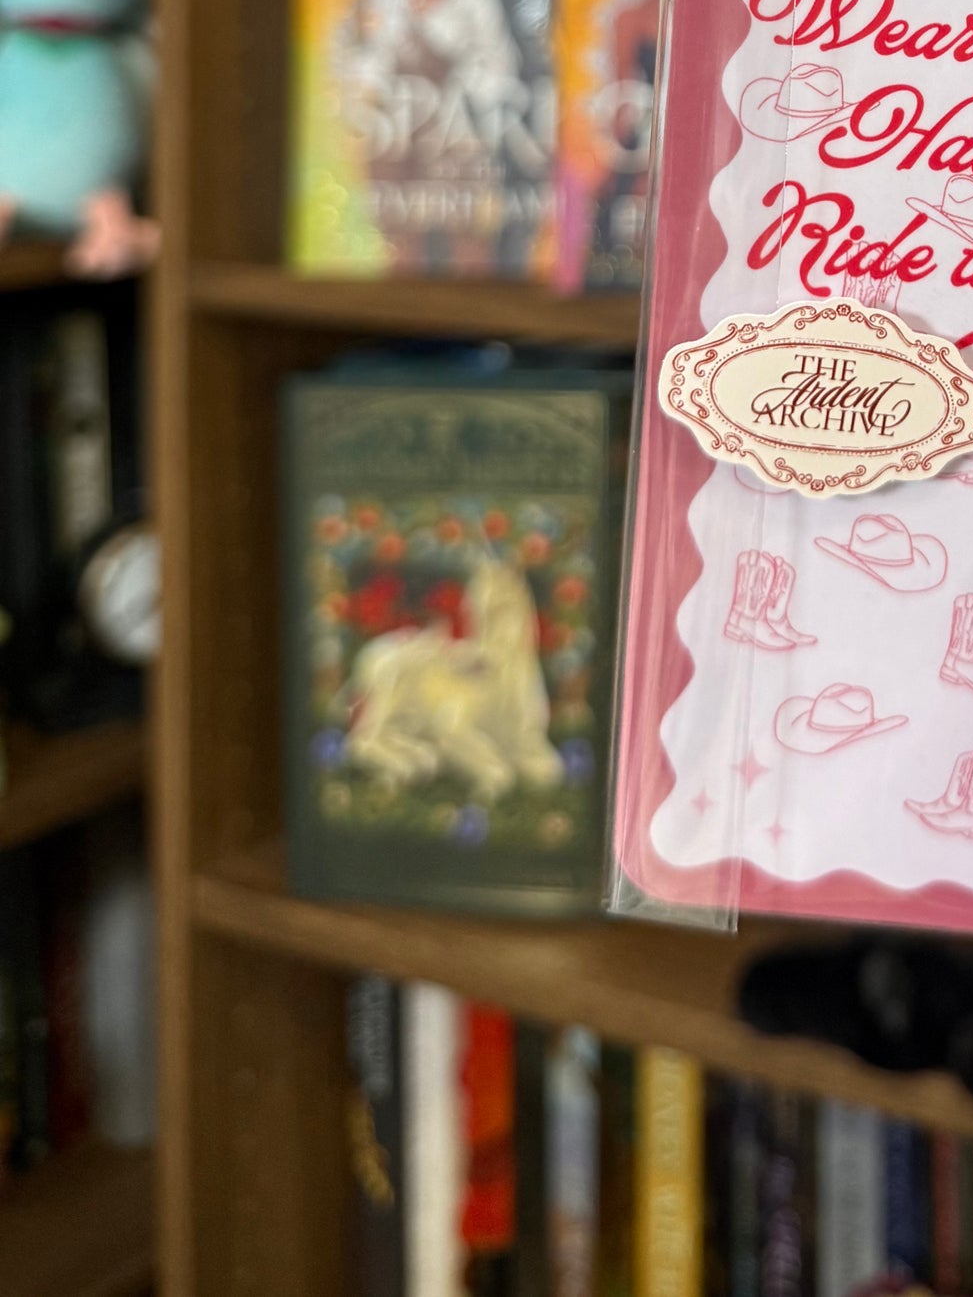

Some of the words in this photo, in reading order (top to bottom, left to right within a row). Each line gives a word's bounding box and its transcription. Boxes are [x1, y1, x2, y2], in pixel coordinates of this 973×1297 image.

[746, 179, 937, 298] Ride
[794, 353, 858, 383] THE
[750, 375, 916, 429] Ardent
[752, 401, 898, 438] ARCHIVE
